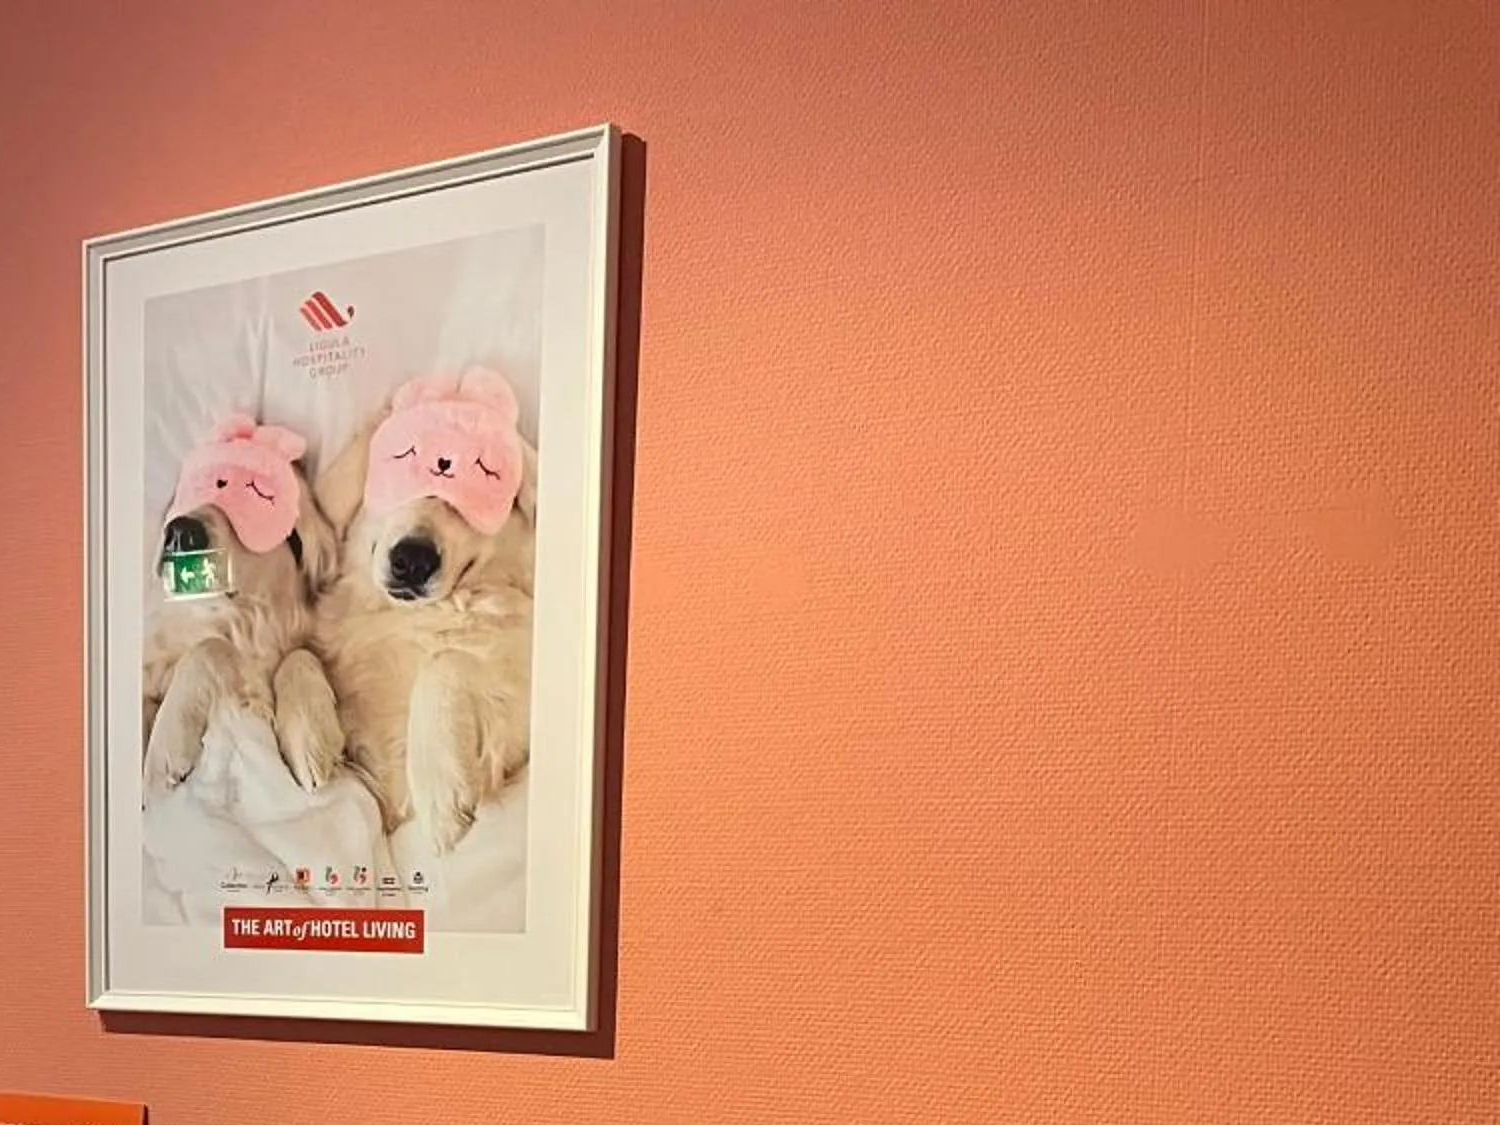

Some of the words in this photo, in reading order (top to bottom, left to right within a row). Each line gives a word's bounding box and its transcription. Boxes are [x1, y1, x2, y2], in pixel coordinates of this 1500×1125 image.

[293, 346, 366, 367] HOSPITALITY
[309, 362, 348, 379] GROUP
[232, 918, 261, 936] THE
[263, 919, 293, 937] ART
[292, 921, 310, 941] of
[310, 920, 359, 938] HOTEL
[363, 921, 416, 939] LIVING
